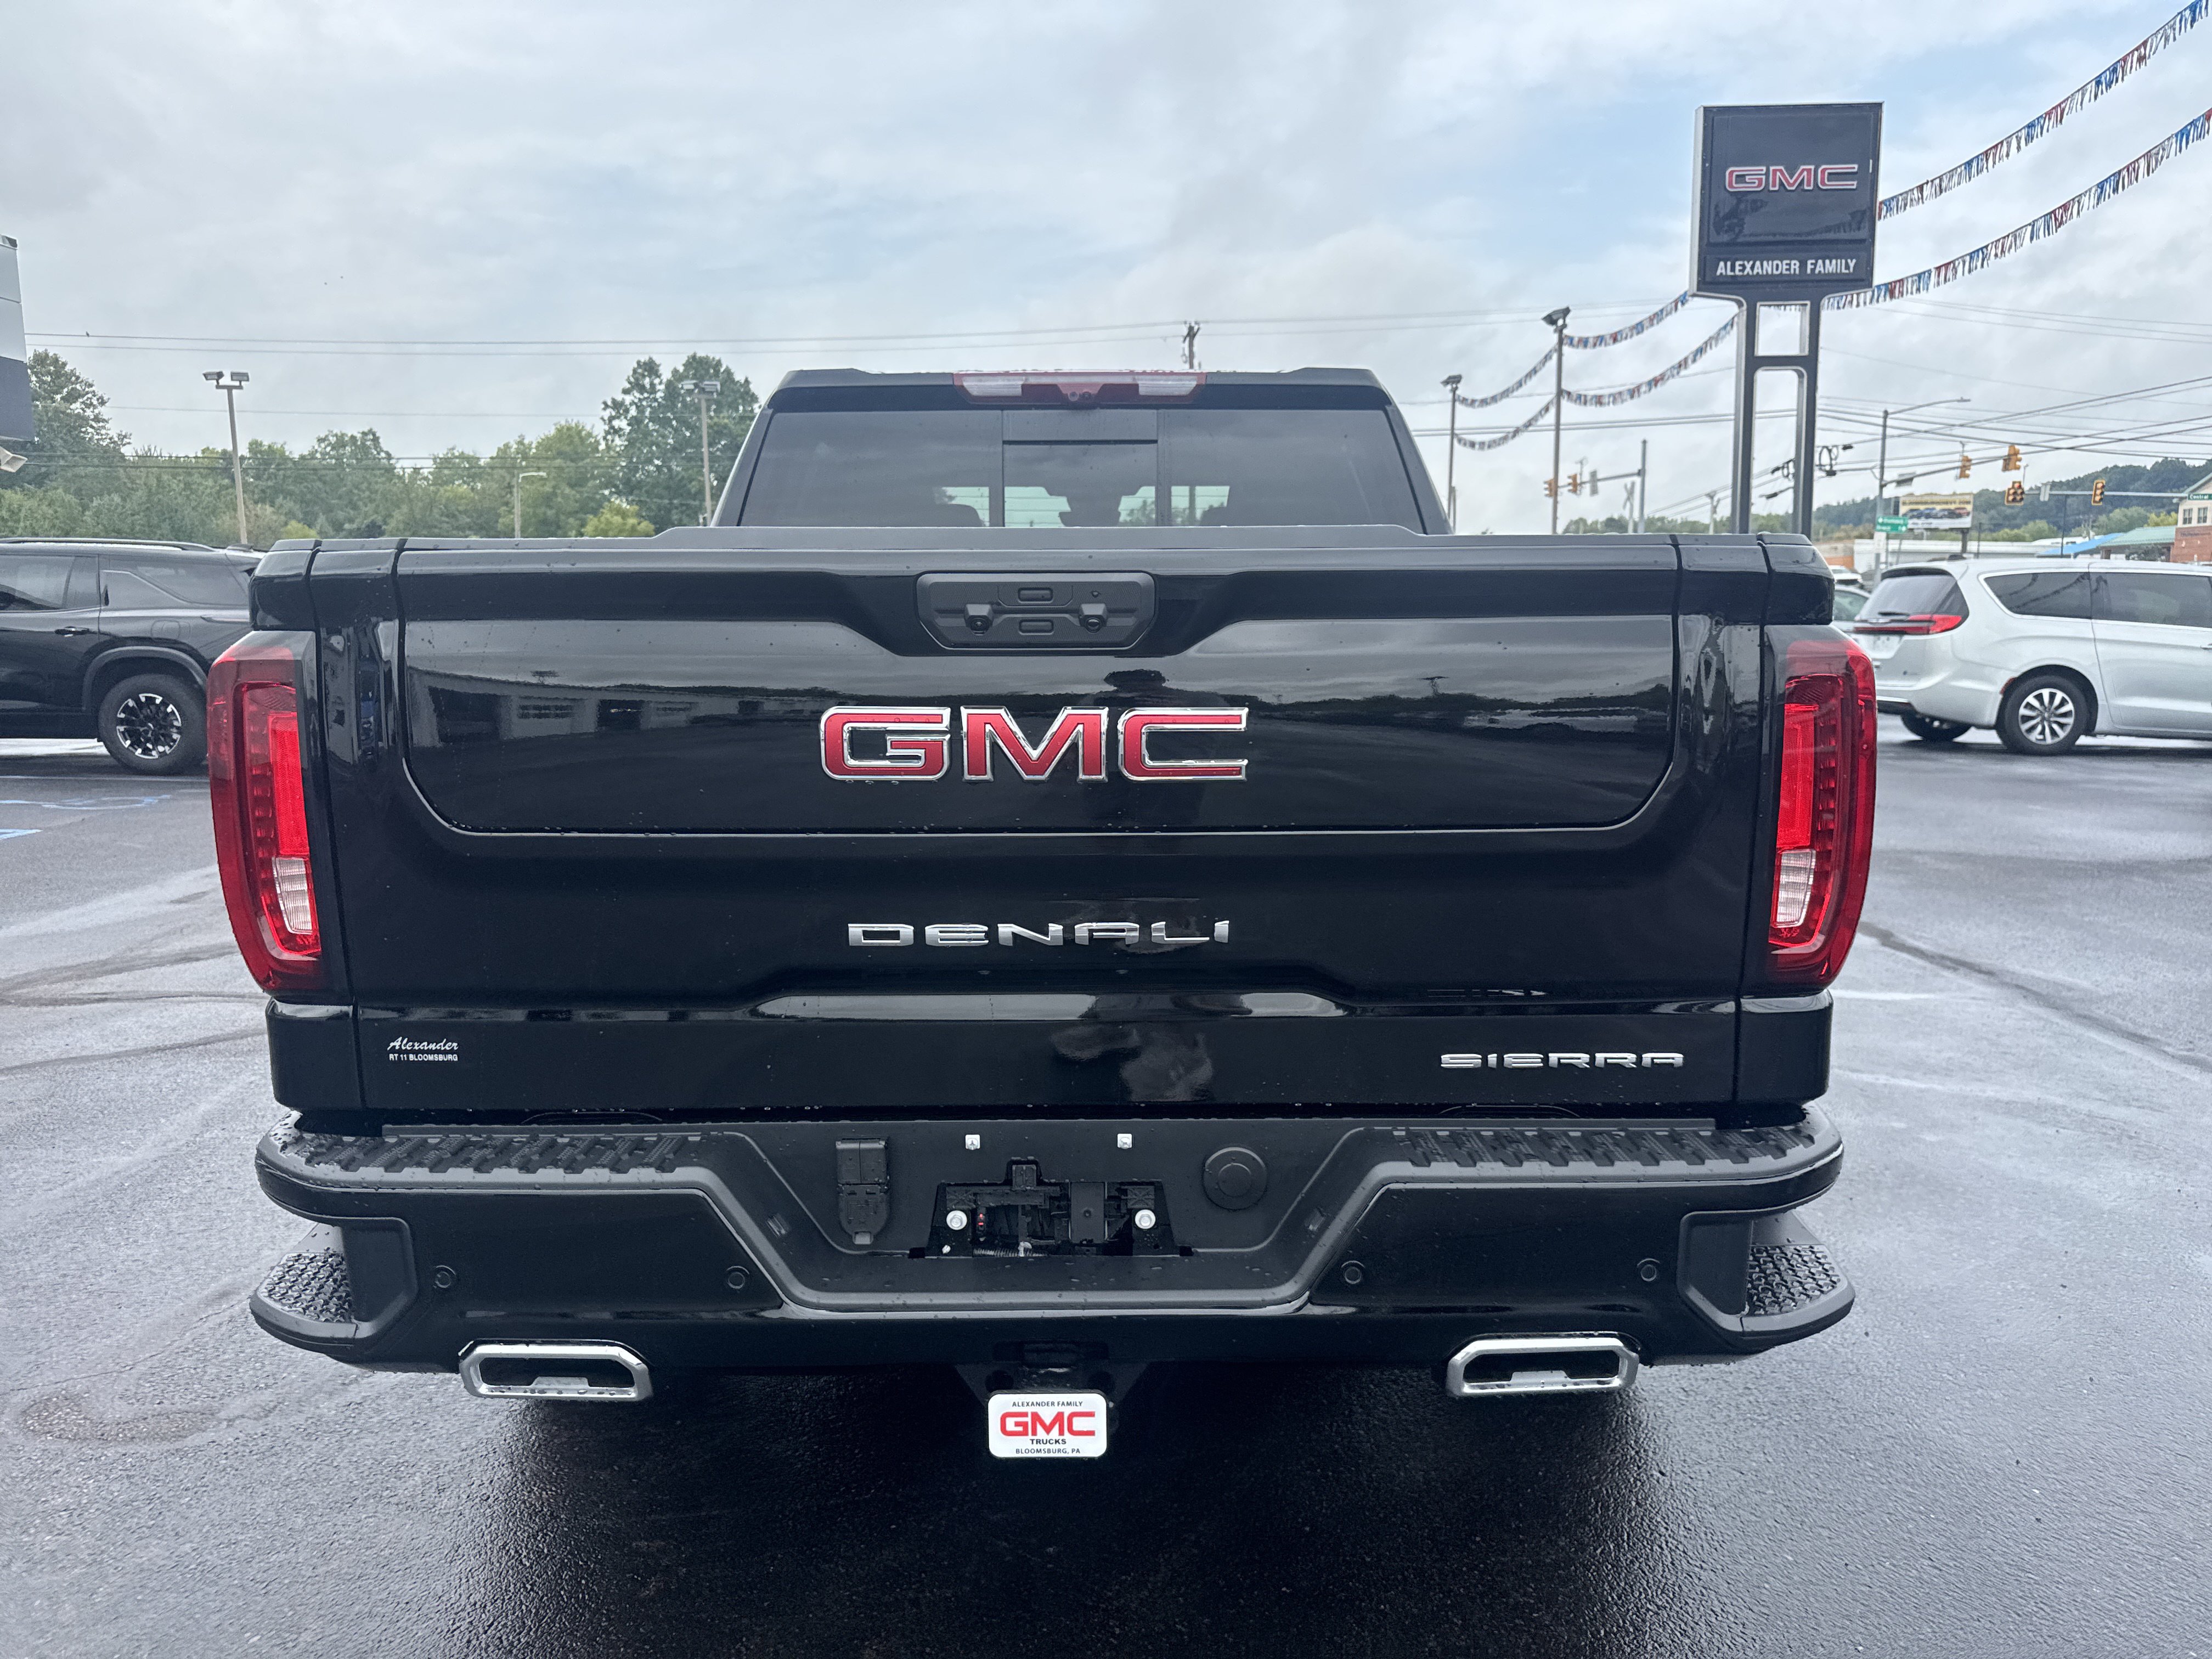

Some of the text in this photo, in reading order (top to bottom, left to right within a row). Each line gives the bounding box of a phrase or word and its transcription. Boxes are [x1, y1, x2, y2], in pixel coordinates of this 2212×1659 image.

[1725, 164, 1858, 191] GMC
[1716, 259, 1856, 276] ALEXANDER FAMILY
[820, 706, 1249, 782] GMC
[848, 921, 1230, 946] DENALI
[387, 1036, 459, 1051] Alexander
[409, 1053, 458, 1062] BLOOMSBURG
[1441, 1053, 1685, 1069] SIERRA
[1000, 1411, 1096, 1436] GMC
